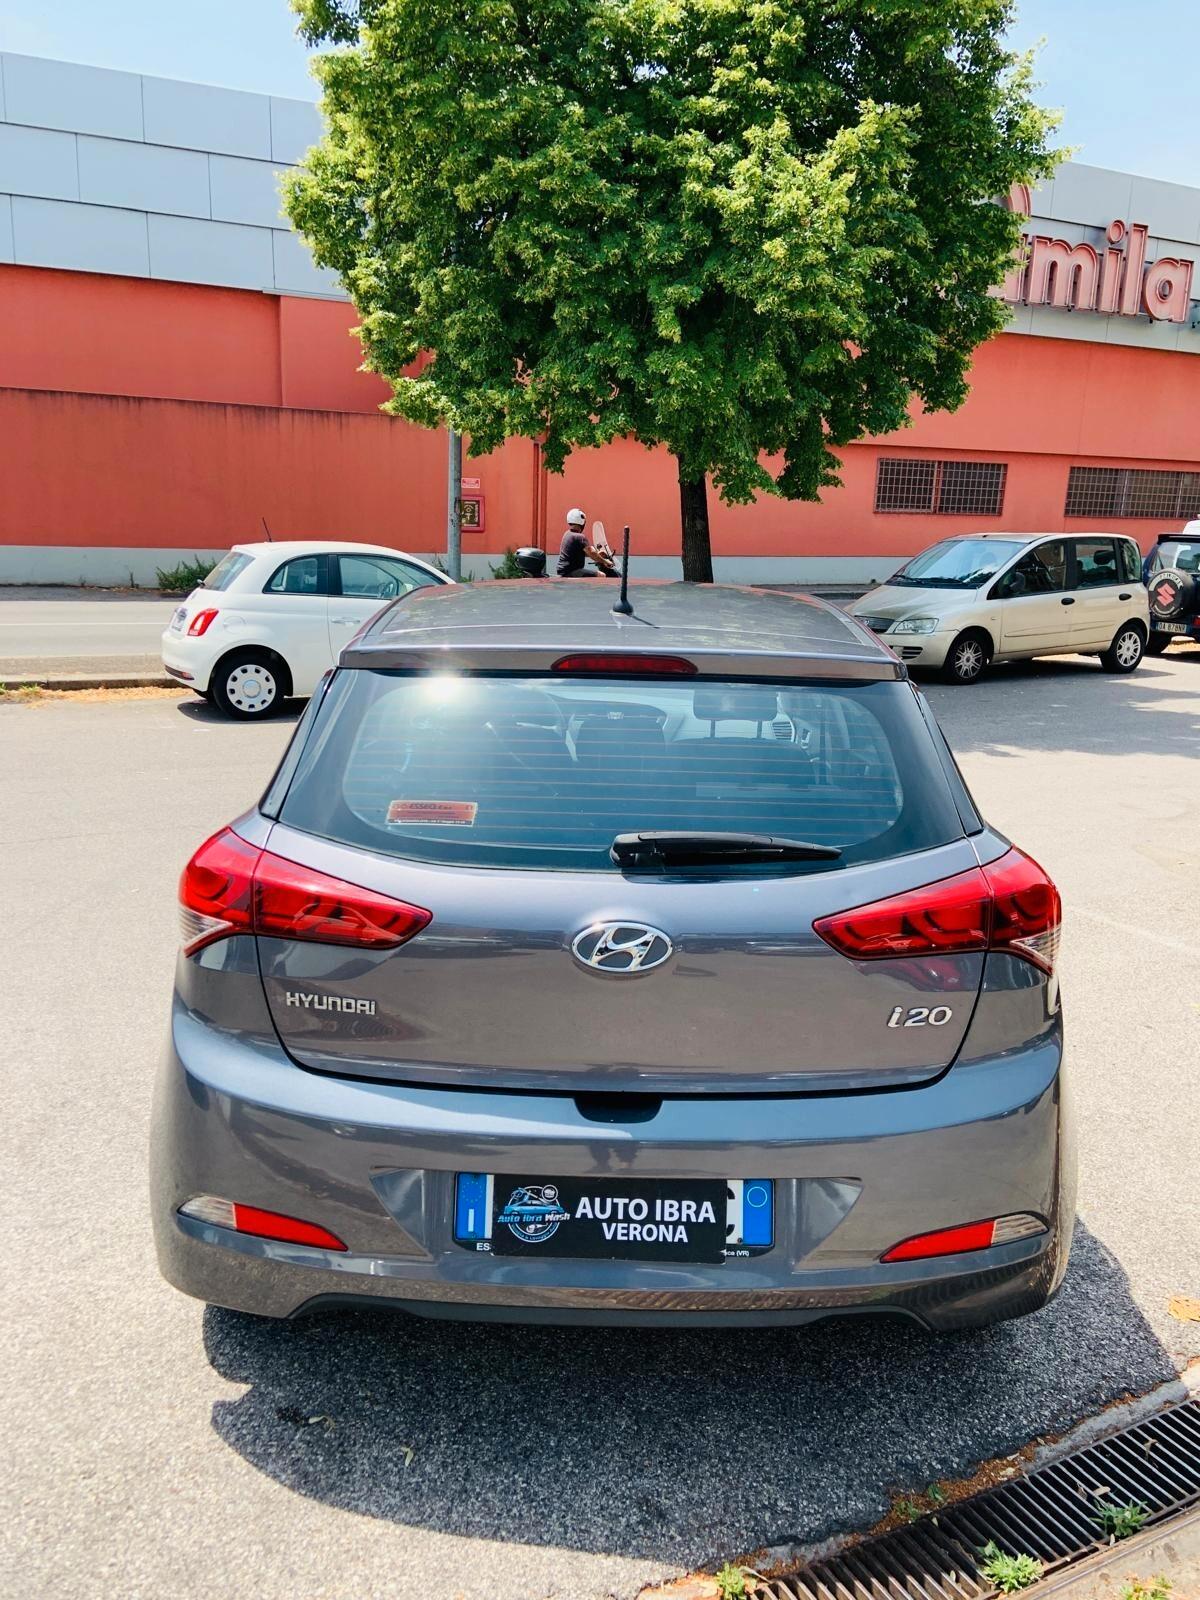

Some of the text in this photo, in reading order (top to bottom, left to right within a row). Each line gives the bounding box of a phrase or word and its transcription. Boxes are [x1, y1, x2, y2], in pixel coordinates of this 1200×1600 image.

[987, 182, 1194, 323] mila
[286, 992, 376, 1015] HYUNDAI
[887, 1006, 953, 1028] i20
[468, 1208, 475, 1232] I
[545, 1212, 571, 1222] Wash
[575, 1196, 649, 1221] AUTO
[655, 1199, 717, 1224] IBRA
[602, 1222, 689, 1243] VERONA
[476, 1242, 491, 1251] ES
